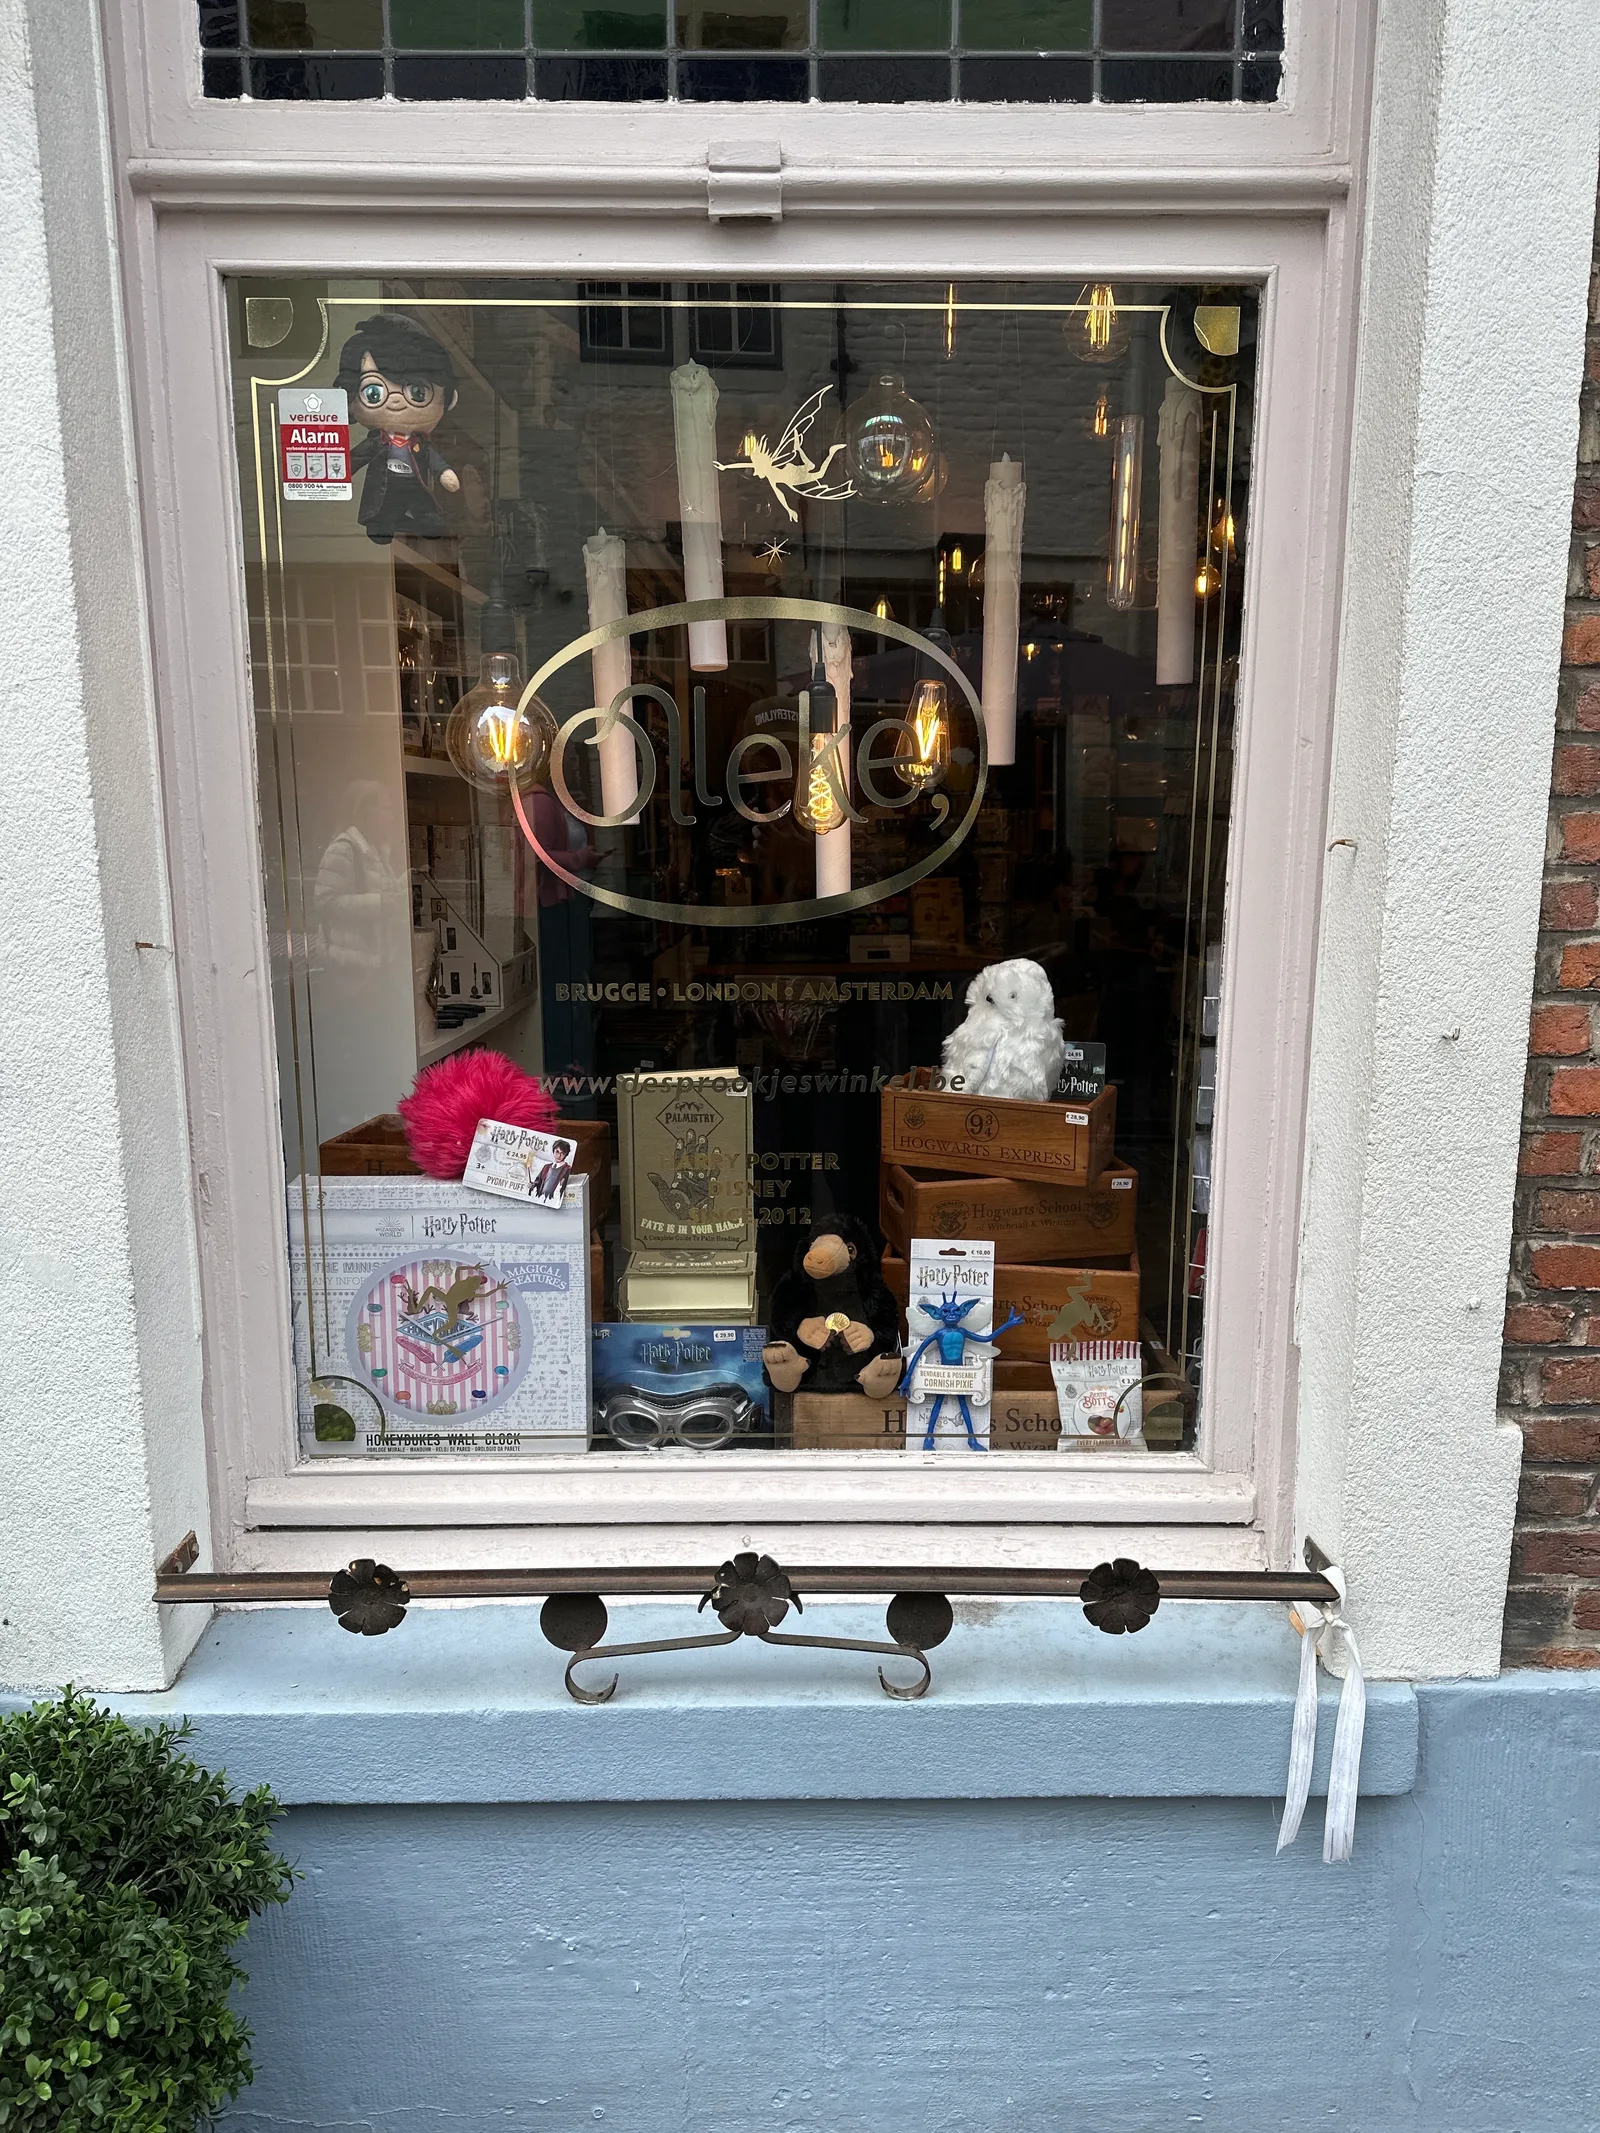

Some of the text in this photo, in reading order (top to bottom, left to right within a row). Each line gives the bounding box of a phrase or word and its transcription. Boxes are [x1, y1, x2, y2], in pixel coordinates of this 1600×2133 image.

[289, 413, 338, 422] verisure
[290, 428, 339, 444] Alarm
[436, 901, 442, 912] 6
[555, 981, 954, 1001] BRUGGE LONDON AMSTERDAM
[538, 1066, 966, 1101] www.desprookjeswinkel.be
[1057, 1076, 1099, 1096] rry Potter
[665, 1112, 715, 1124] PALMISTRY
[490, 1125, 548, 1152] Harry Potter
[899, 1136, 1071, 1166] HOGWARTS EXPRESS
[658, 1152, 840, 1171] HARRY POTTER
[486, 1176, 526, 1192] PYGMY PUFF
[708, 1179, 792, 1198] DISNEY
[758, 1206, 812, 1225] 2012
[972, 1199, 1082, 1221] Hogwarts School
[421, 1213, 497, 1239] Harry Potter
[640, 1217, 665, 1232] FATE
[666, 1223, 675, 1234] IS
[678, 1224, 688, 1235] IN
[690, 1224, 714, 1235] YOUR
[976, 1217, 1076, 1232] of Witchcraft & Wizardry
[649, 1235, 674, 1243] Complete
[716, 1235, 740, 1243] Reading
[314, 1262, 339, 1273] THE
[343, 1262, 380, 1274] MINIS
[715, 1258, 744, 1266] HANDS
[506, 1264, 562, 1279] MAGICAL
[917, 1264, 989, 1291] Harry Potter
[312, 1276, 333, 1286] ANY
[510, 1273, 567, 1290] REATURES
[1021, 1295, 1064, 1313] Scho
[640, 1342, 673, 1364] Harry
[674, 1340, 713, 1371] Potter
[920, 1370, 946, 1378] BENDABLE
[952, 1371, 977, 1380] POSEABLE
[1087, 1365, 1107, 1379] Harry
[1106, 1363, 1128, 1378] Potter
[924, 1378, 974, 1389] CORNISH PIXIE
[1005, 1408, 1062, 1434] Scho
[366, 1432, 521, 1447] HONEYDUKES WALL CLOCK
[1115, 1438, 1132, 1446] BEANS
